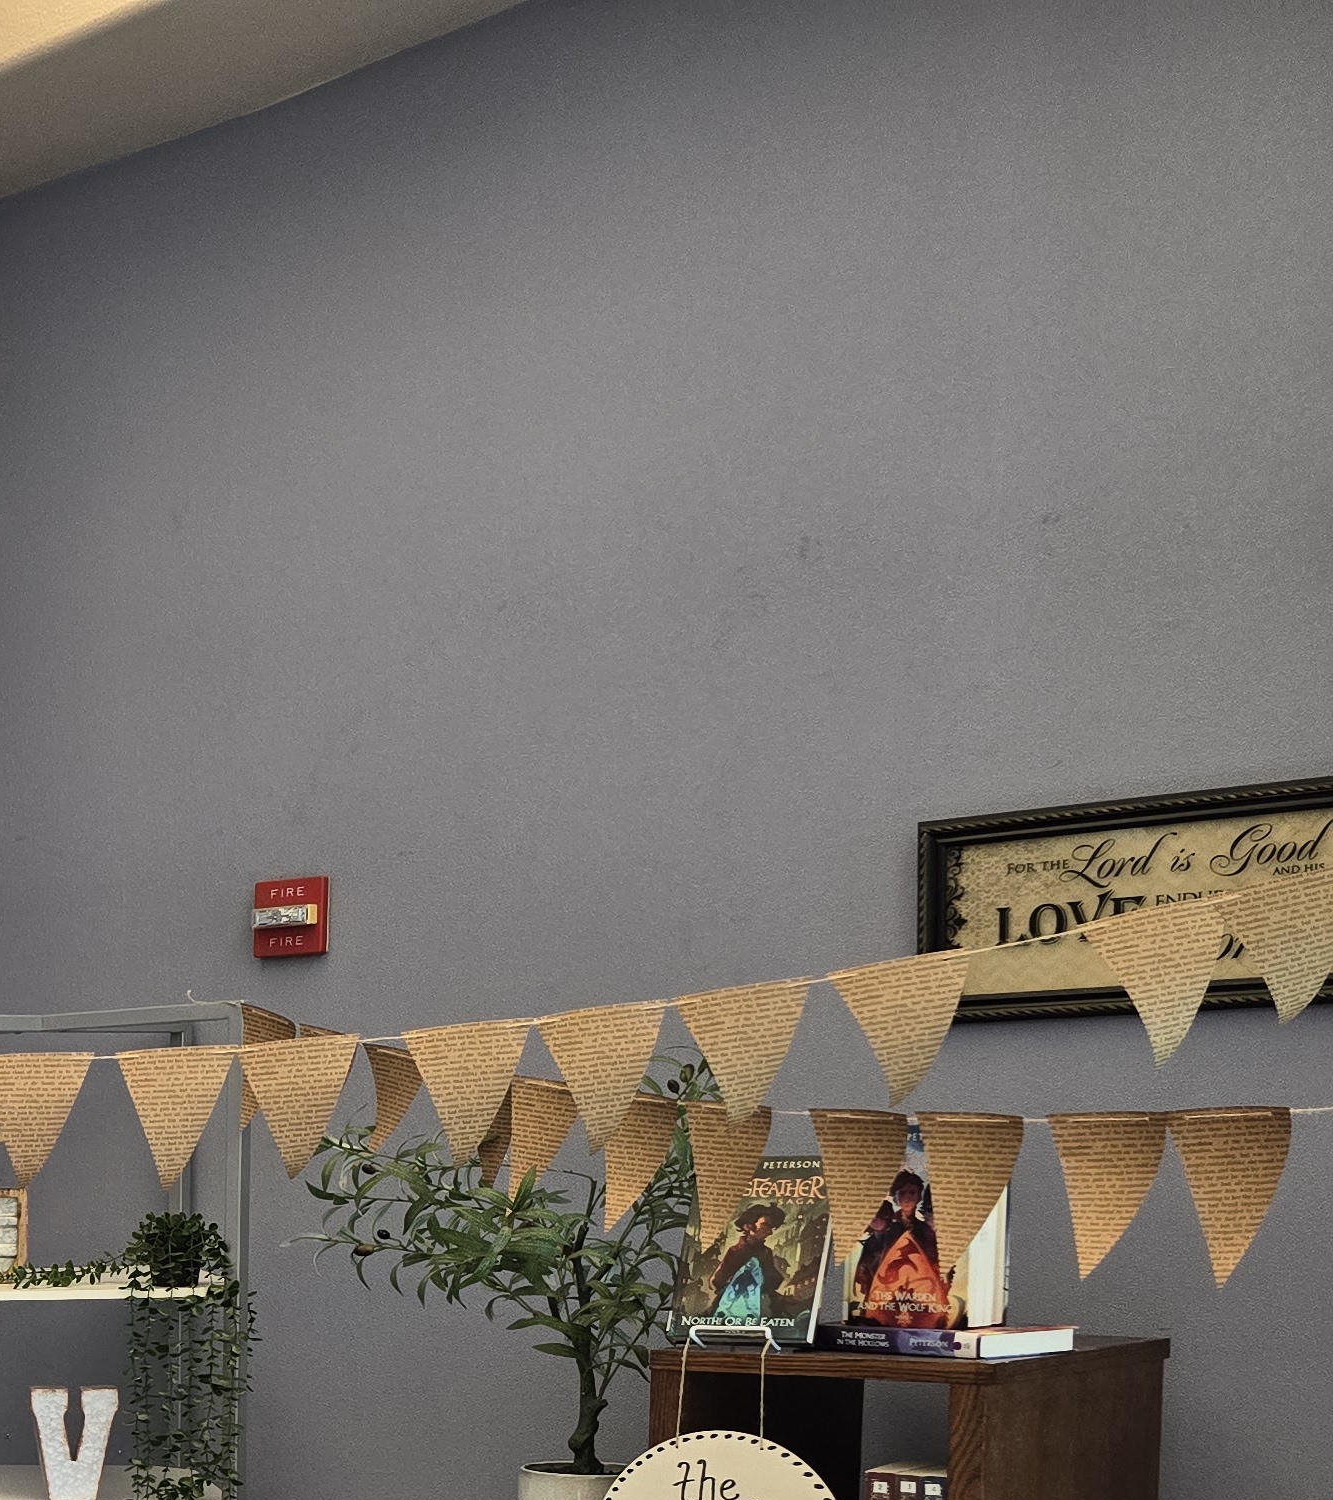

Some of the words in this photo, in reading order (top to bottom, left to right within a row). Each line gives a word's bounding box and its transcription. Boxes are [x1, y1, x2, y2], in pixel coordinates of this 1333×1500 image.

[1007, 862, 1036, 875] FOR
[1039, 859, 1070, 871] THE
[1059, 832, 1177, 889] Lord
[1170, 848, 1196, 873] is
[1209, 818, 1333, 877] Good
[1273, 863, 1301, 876] AND
[270, 886, 305, 899] FIRE
[269, 935, 304, 948] FIRE
[763, 1161, 821, 1169] PETERSON
[874, 1290, 893, 1301] THE
[894, 1291, 937, 1302] WARDEN
[879, 1302, 896, 1311] THE
[898, 1302, 926, 1312] WOLF
[760, 1316, 795, 1327] EATEN
